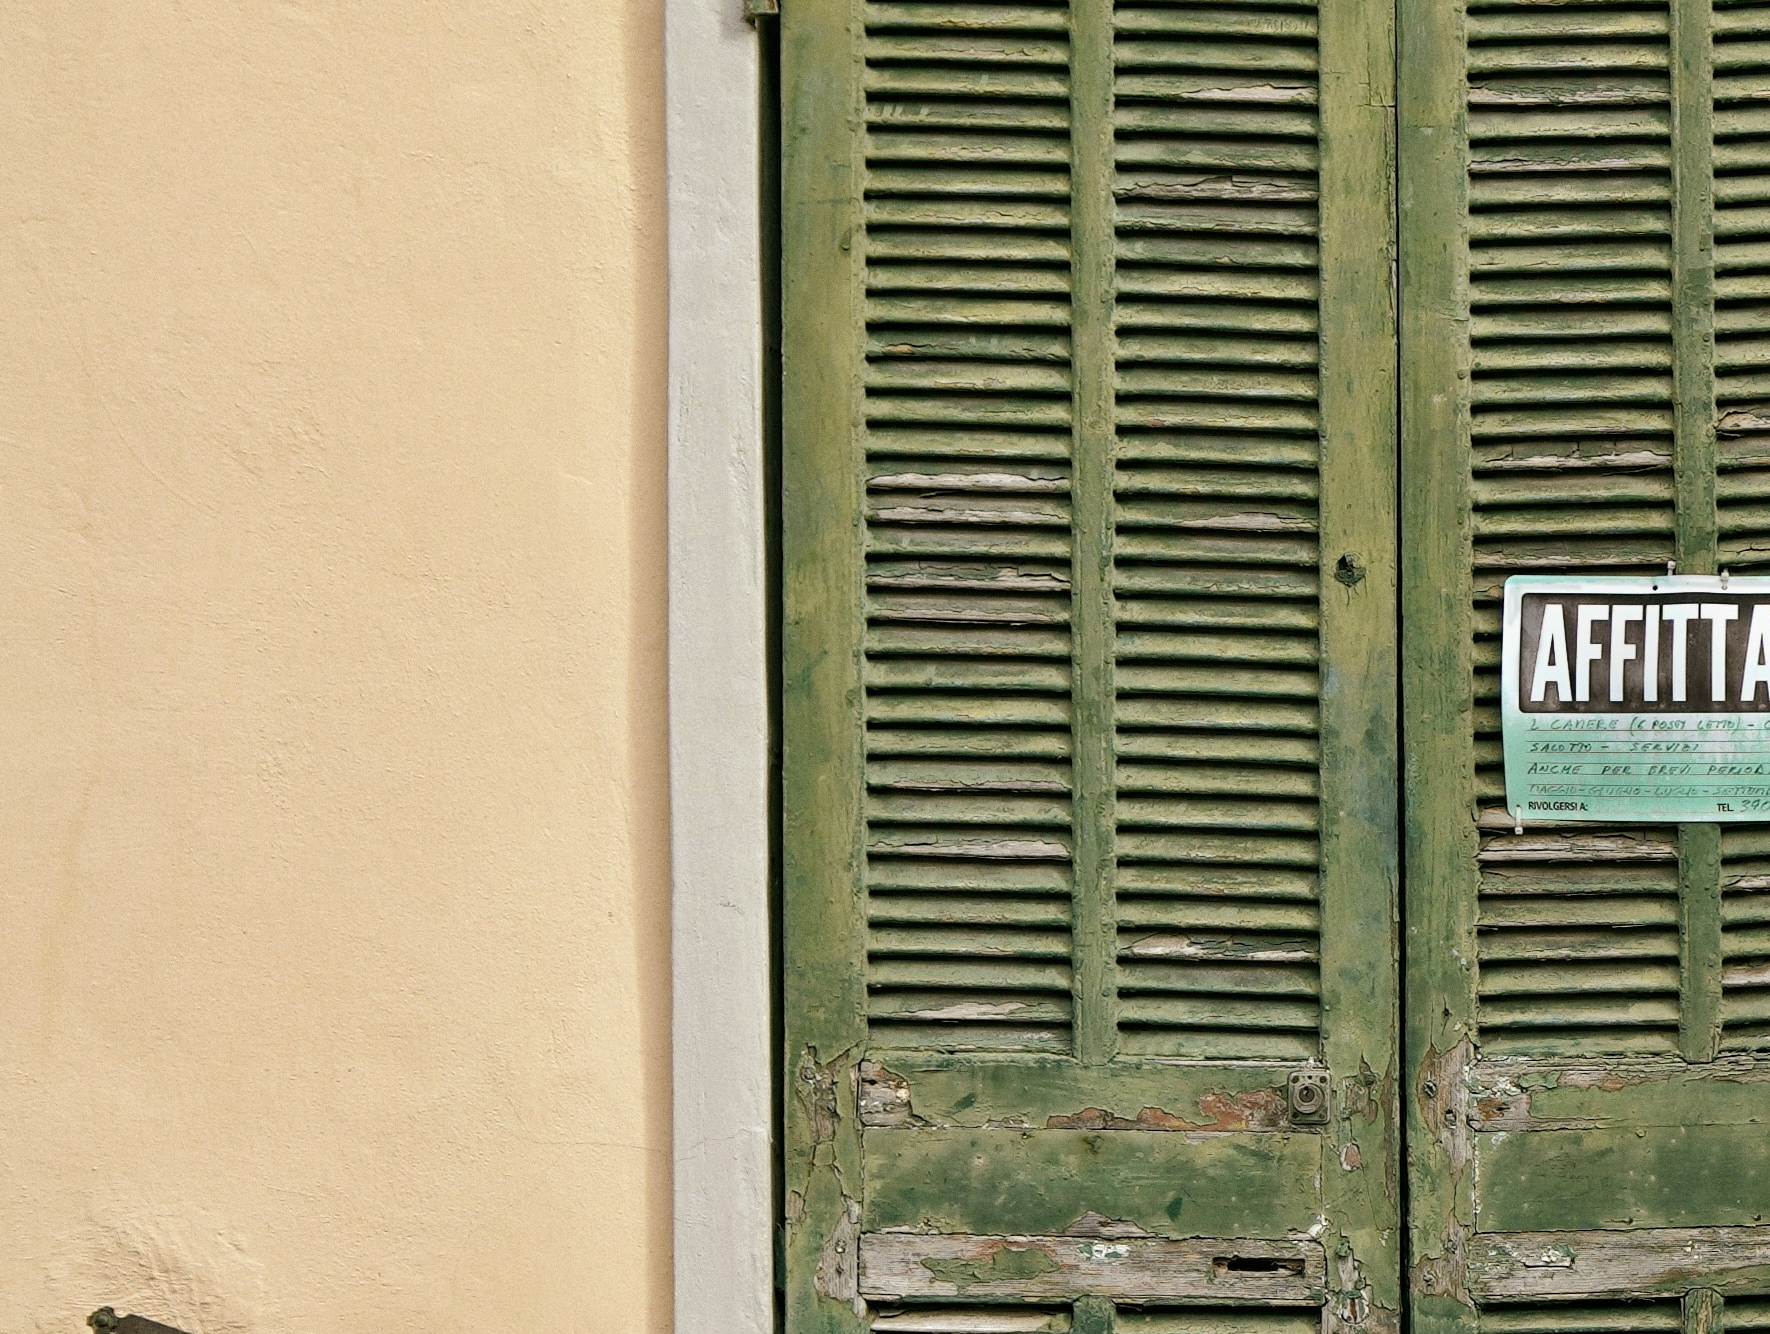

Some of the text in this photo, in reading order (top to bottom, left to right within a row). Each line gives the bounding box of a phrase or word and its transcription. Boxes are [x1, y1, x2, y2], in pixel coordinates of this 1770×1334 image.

[1629, 742, 1699, 752] SERVIZI
[1528, 762, 1584, 774] ANCHE
[1601, 765, 1633, 775] PER
[1647, 764, 1691, 775] BREVI
[1528, 801, 1577, 811] RIVOLGERSI
